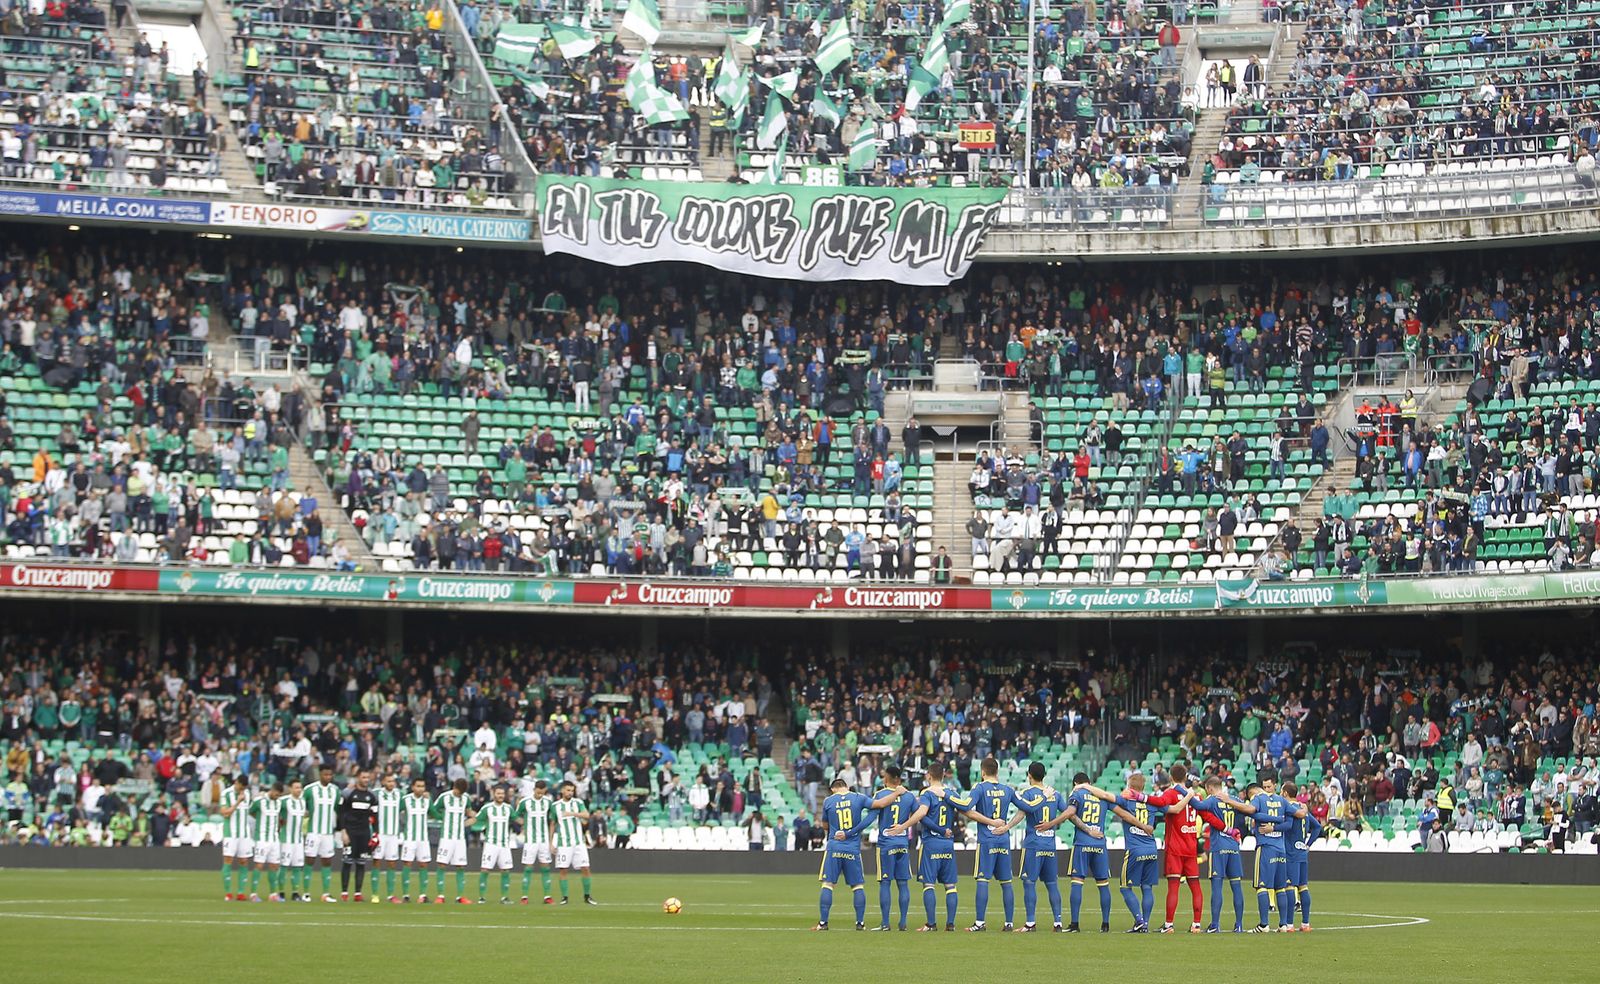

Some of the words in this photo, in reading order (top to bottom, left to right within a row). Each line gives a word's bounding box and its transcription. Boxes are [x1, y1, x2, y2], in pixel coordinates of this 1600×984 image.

[961, 131, 992, 142] BETIS
[230, 205, 317, 224] TENORIO
[462, 219, 528, 239] CATERING
[543, 182, 590, 245] EN
[594, 189, 669, 248] TUS
[672, 193, 800, 263] COLORES
[800, 194, 896, 272] PUSE
[889, 198, 948, 269] MI
[12, 564, 112, 590] Cruzcampo
[215, 571, 246, 589] ¡Te
[247, 573, 308, 595] quiero
[310, 574, 365, 593] Betis!
[417, 577, 512, 602] Cruzcampo
[638, 584, 731, 607] Cruzcampo
[844, 586, 942, 610] Cruzcampo
[1049, 589, 1077, 605] ¡Te
[1080, 589, 1139, 610] quiero
[1144, 588, 1194, 605] Betis!
[836, 808, 853, 830] 19
[939, 806, 947, 826] 6
[992, 798, 1001, 819] 3
[1082, 801, 1100, 824] 22
